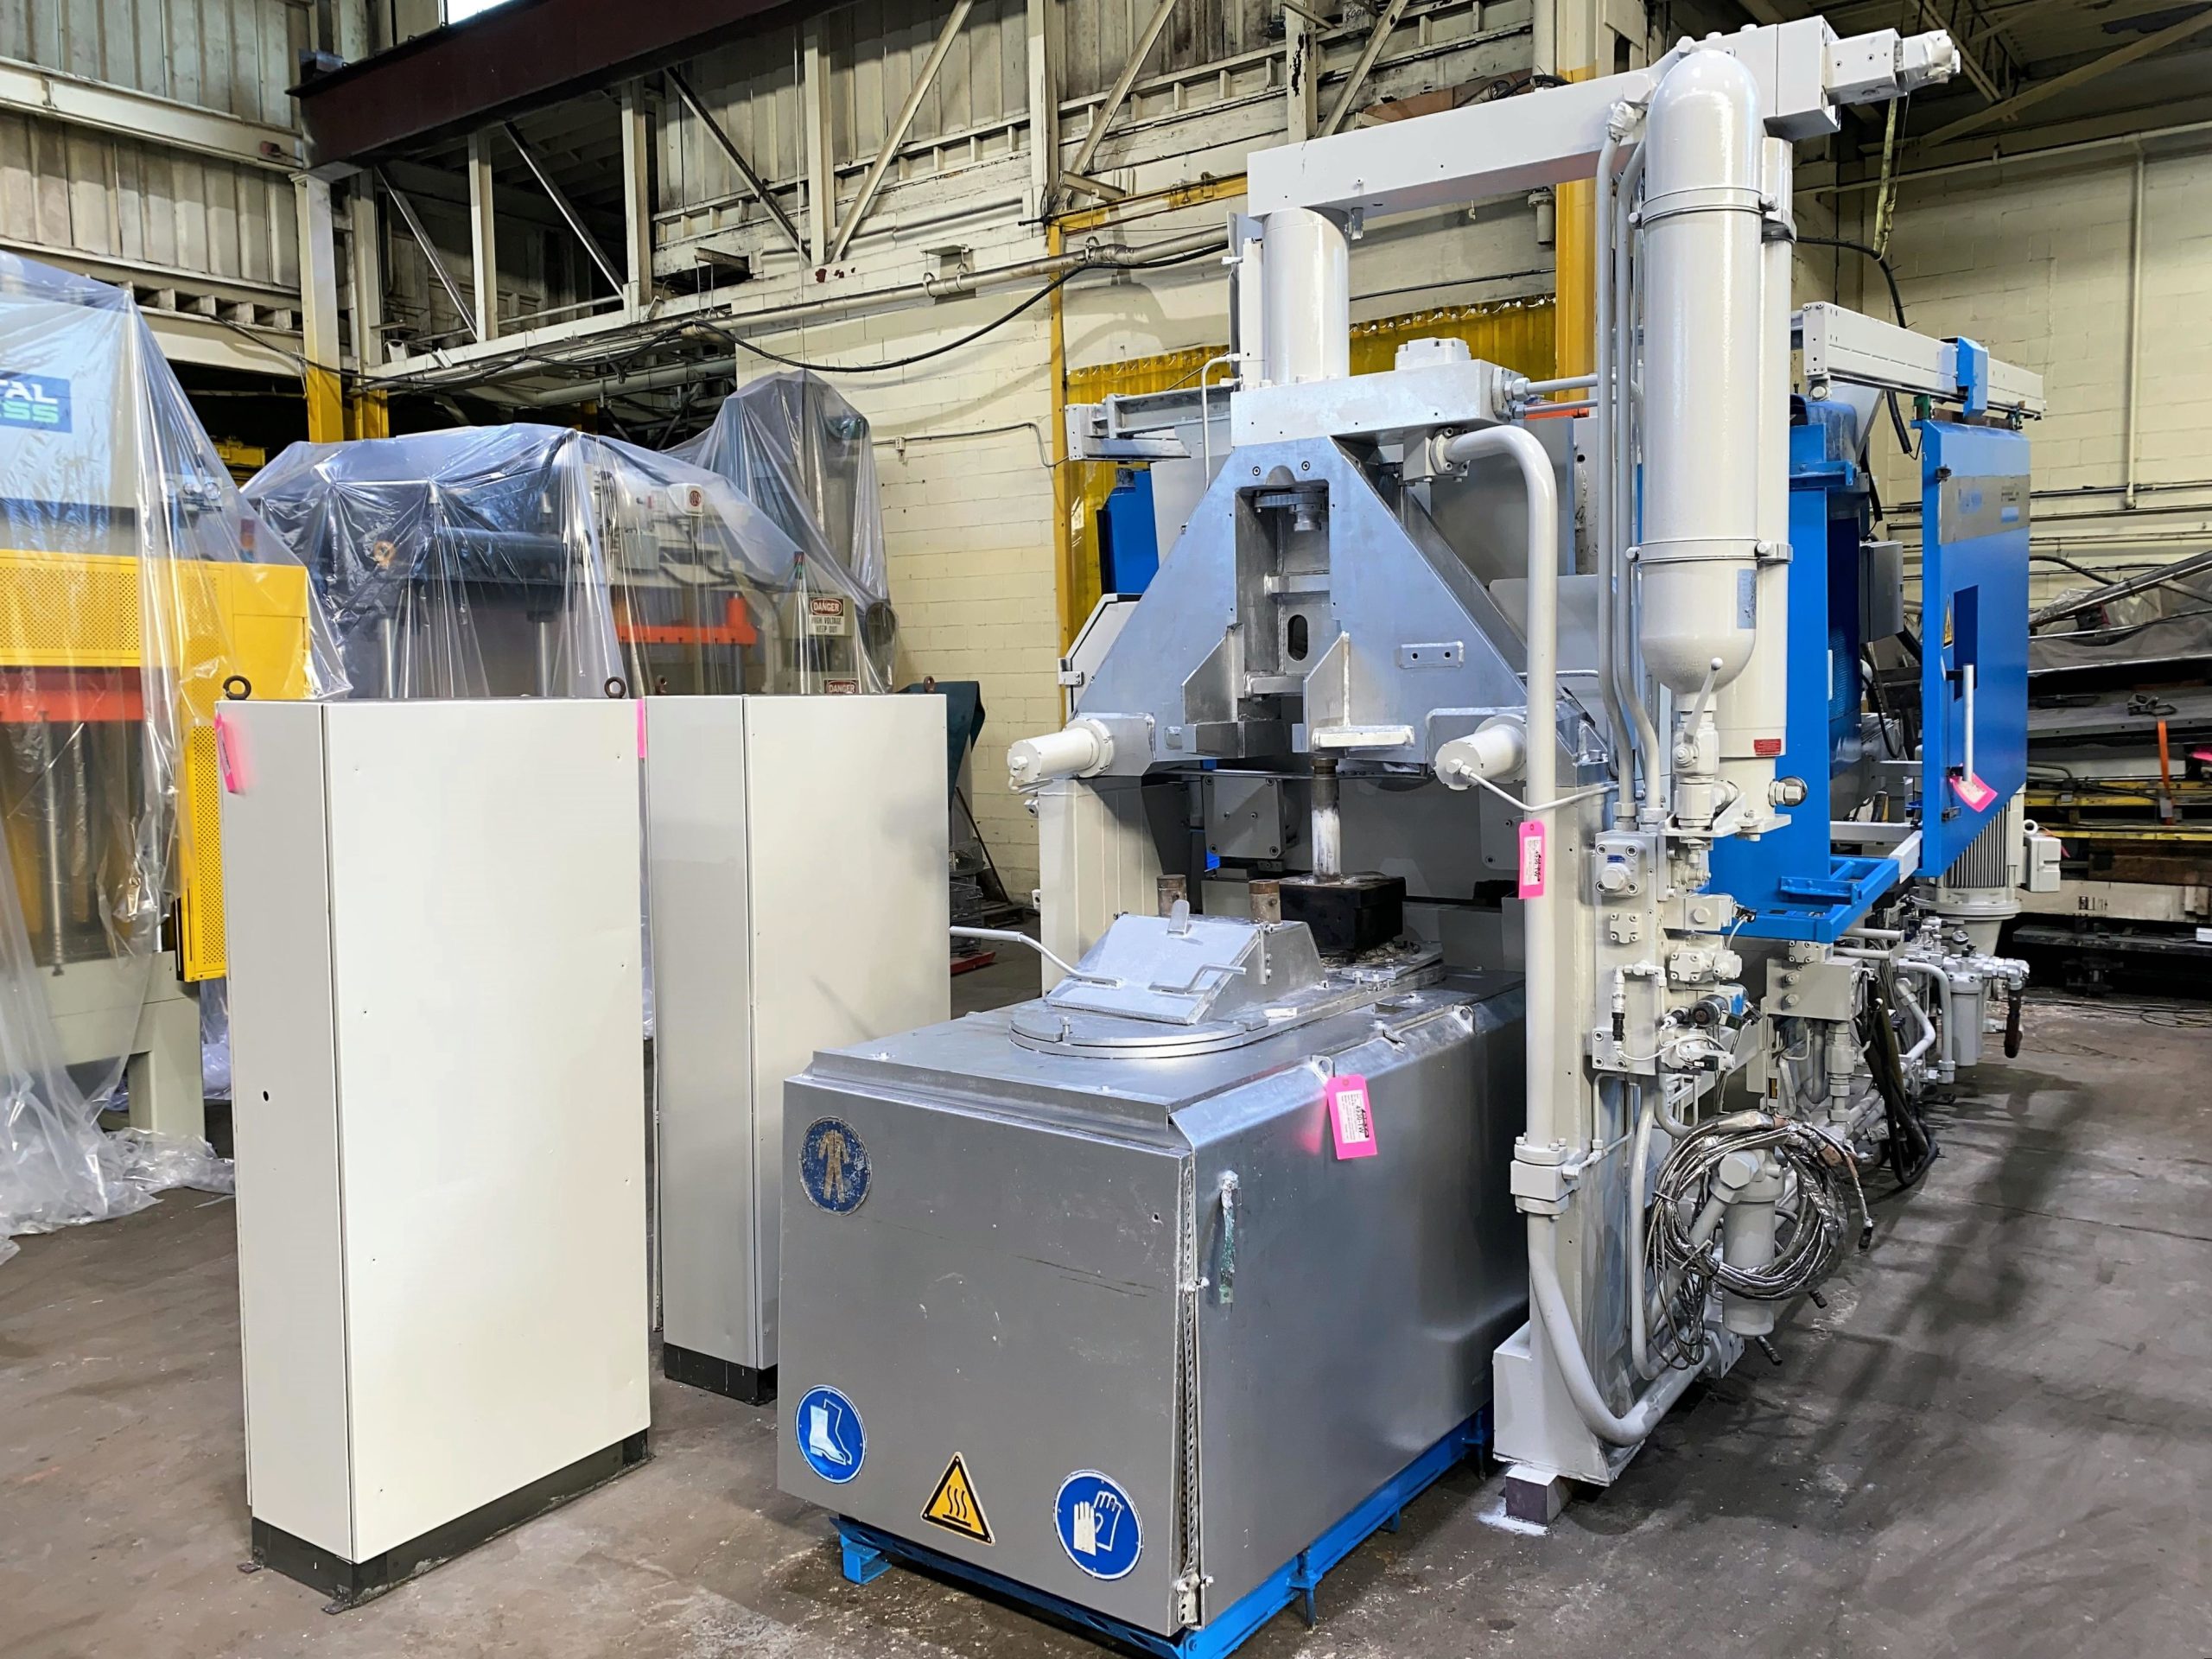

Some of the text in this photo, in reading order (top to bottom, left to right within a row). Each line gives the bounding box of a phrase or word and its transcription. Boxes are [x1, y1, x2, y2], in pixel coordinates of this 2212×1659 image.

[813, 601, 840, 612] DANGER
[829, 683, 855, 693] DANGER
[1356, 1105, 1364, 1134] 4930-TW
